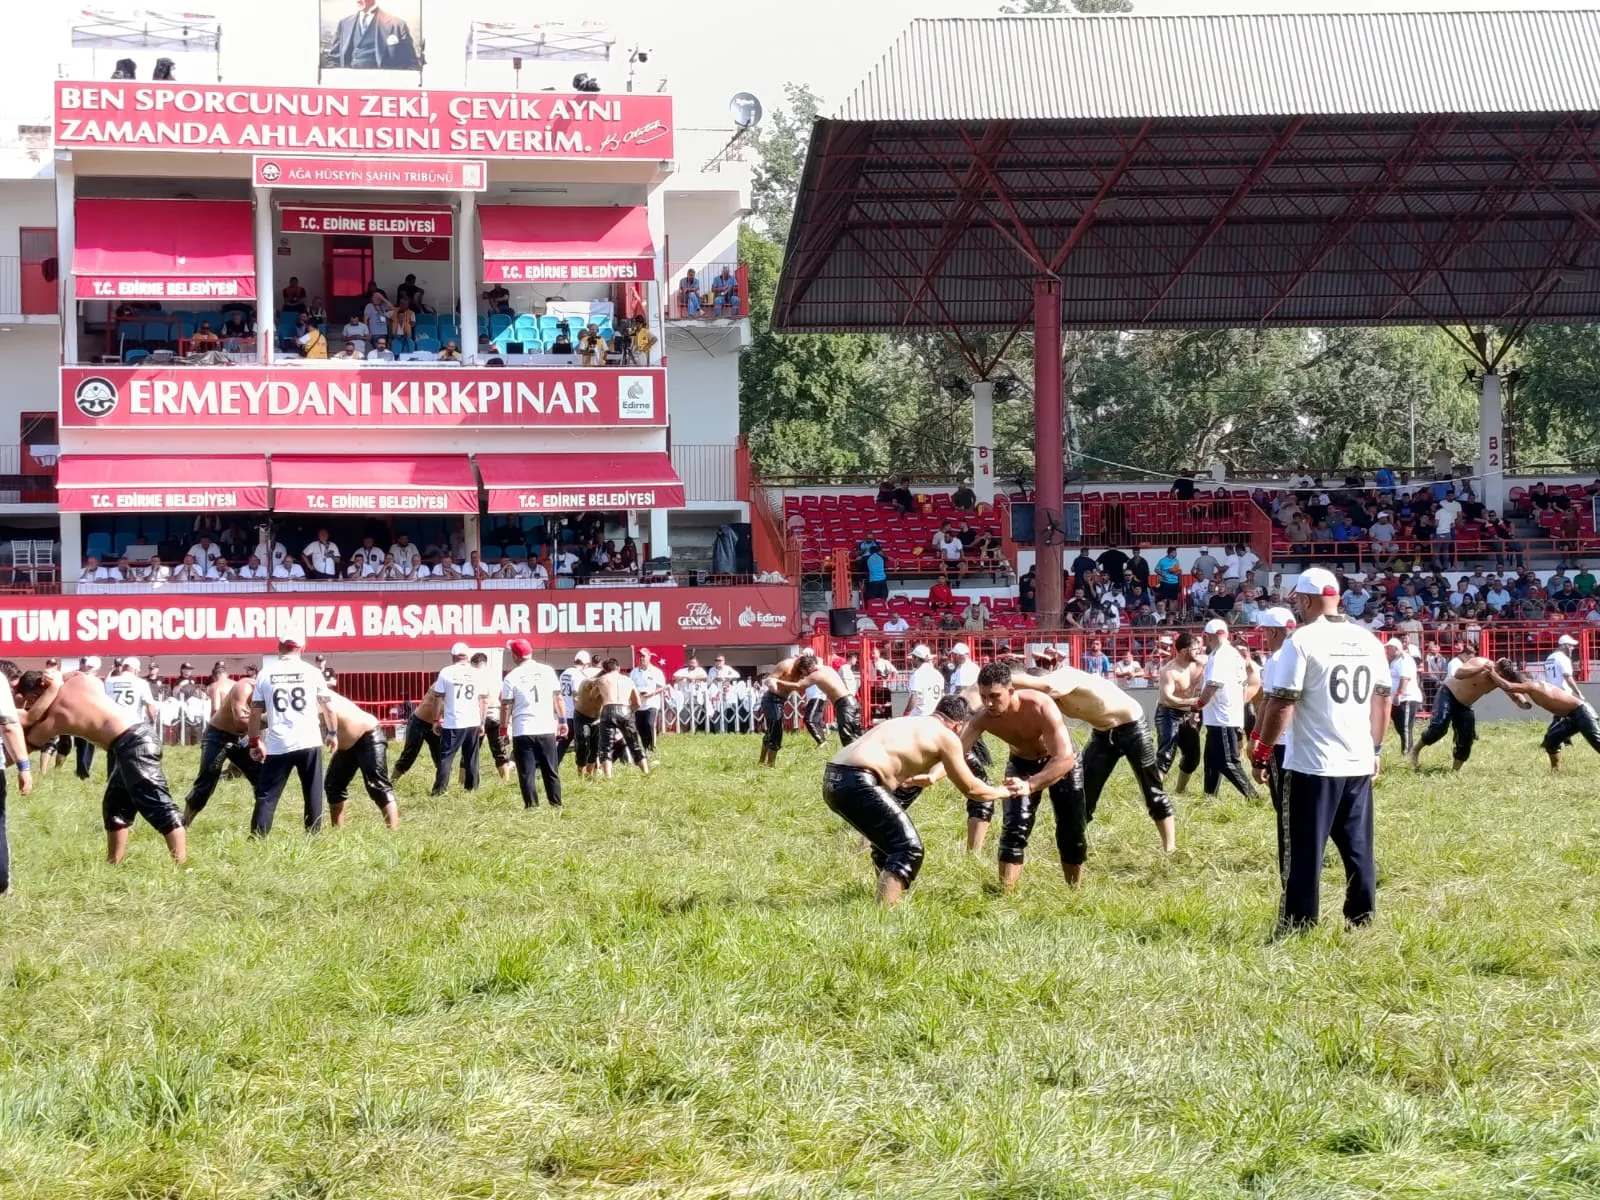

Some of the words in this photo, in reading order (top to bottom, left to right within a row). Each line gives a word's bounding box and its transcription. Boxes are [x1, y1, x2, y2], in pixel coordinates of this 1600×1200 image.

[60, 87, 124, 110] BEN
[135, 89, 349, 116] SPORCUNUN
[361, 92, 437, 124] ZEKİ,
[449, 94, 541, 125] ÇEVİK
[550, 100, 622, 121] AYNI
[60, 119, 231, 145] ZAMANDA
[239, 123, 441, 148] AHLAKLISINI
[450, 125, 592, 152] SEVERİM.
[288, 168, 311, 180] AĞA
[315, 167, 362, 181] HÜSEYİN
[299, 216, 320, 230] T.C.
[323, 216, 366, 231] EDİRNE
[369, 217, 435, 232] BELEDİYESİ
[502, 265, 523, 279] T.C.
[525, 264, 569, 279] EDİRNE
[570, 263, 637, 278] BELEDİYESİ
[93, 281, 116, 295] T.C.
[118, 280, 164, 295] EDİRNE
[166, 280, 237, 295] BELEDİYESİ
[129, 381, 372, 415] ERMEYDANI
[382, 381, 600, 415] KIRKPINAR
[622, 401, 650, 409] Edirne
[91, 493, 114, 508] T.C.
[117, 492, 162, 507] EDİRNE
[165, 491, 237, 507] BELEDİYESİ
[307, 494, 329, 508] T.C.
[332, 493, 376, 508] EDİRNE
[379, 494, 448, 509] BELEDİYESİ
[519, 494, 541, 509] T.C.
[543, 492, 587, 507] EDİRNE
[589, 490, 656, 506] BELEDİYESİ
[0, 608, 70, 642] TÜM
[76, 605, 357, 641] SPORCULARIMIZA
[361, 603, 531, 638] BAŞARILAR
[756, 612, 786, 623] Edirne
[453, 683, 475, 701] 78
[1329, 664, 1371, 705] 60
[112, 690, 135, 706] 75
[272, 687, 307, 713] 68
